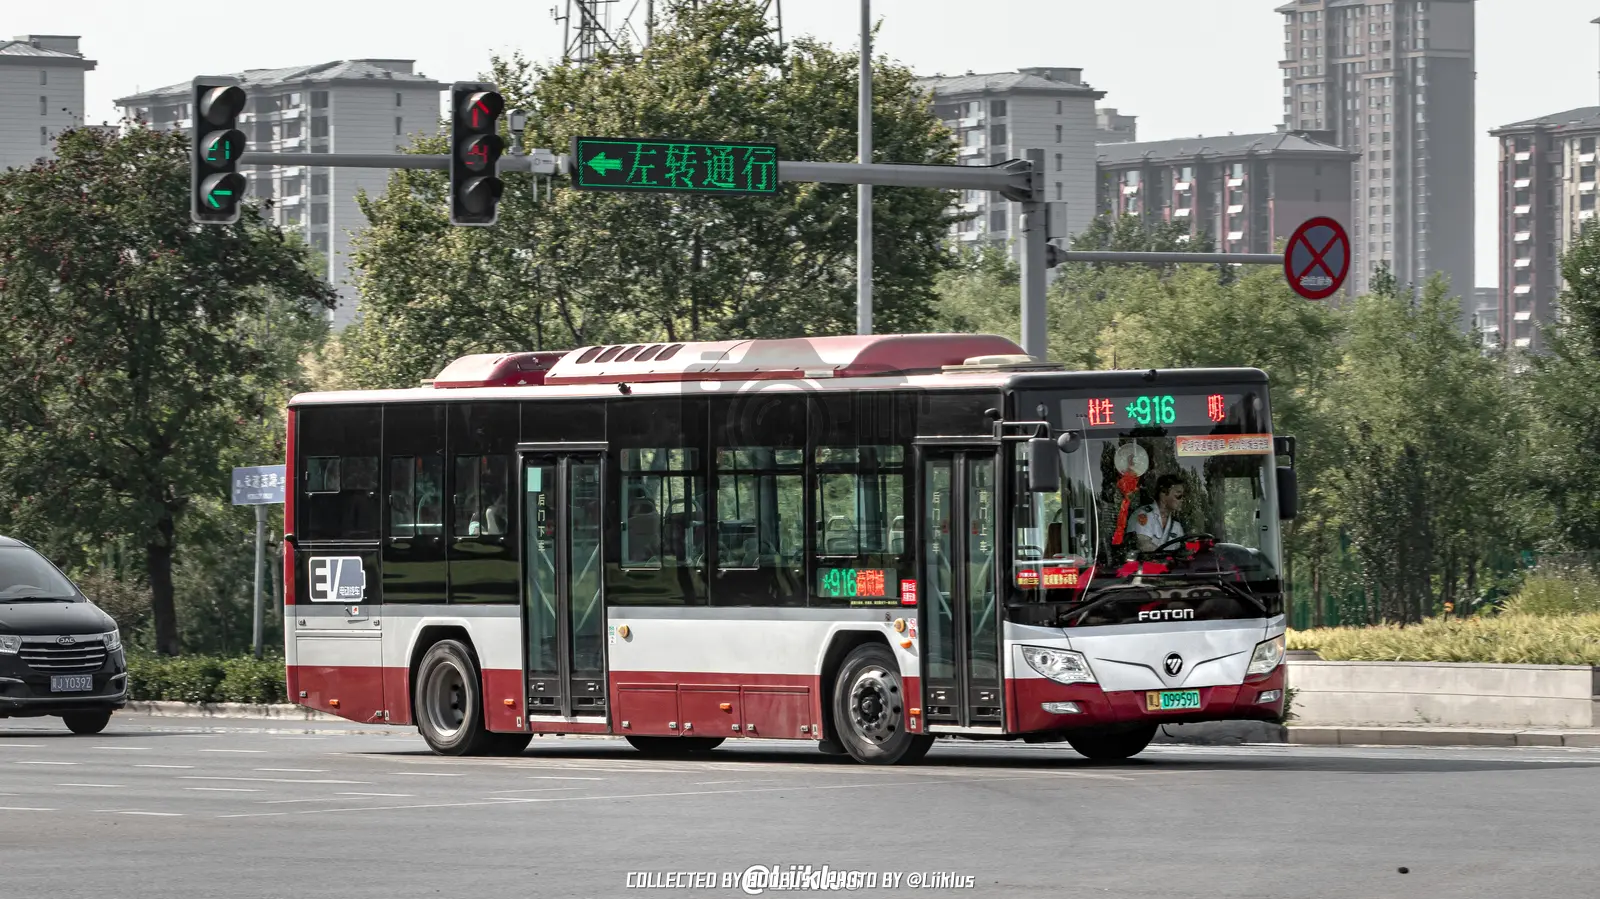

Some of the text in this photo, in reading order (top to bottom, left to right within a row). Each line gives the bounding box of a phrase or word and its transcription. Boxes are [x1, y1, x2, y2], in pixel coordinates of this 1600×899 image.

[626, 142, 774, 190] 左转通行
[1138, 608, 1194, 622] FOTON
